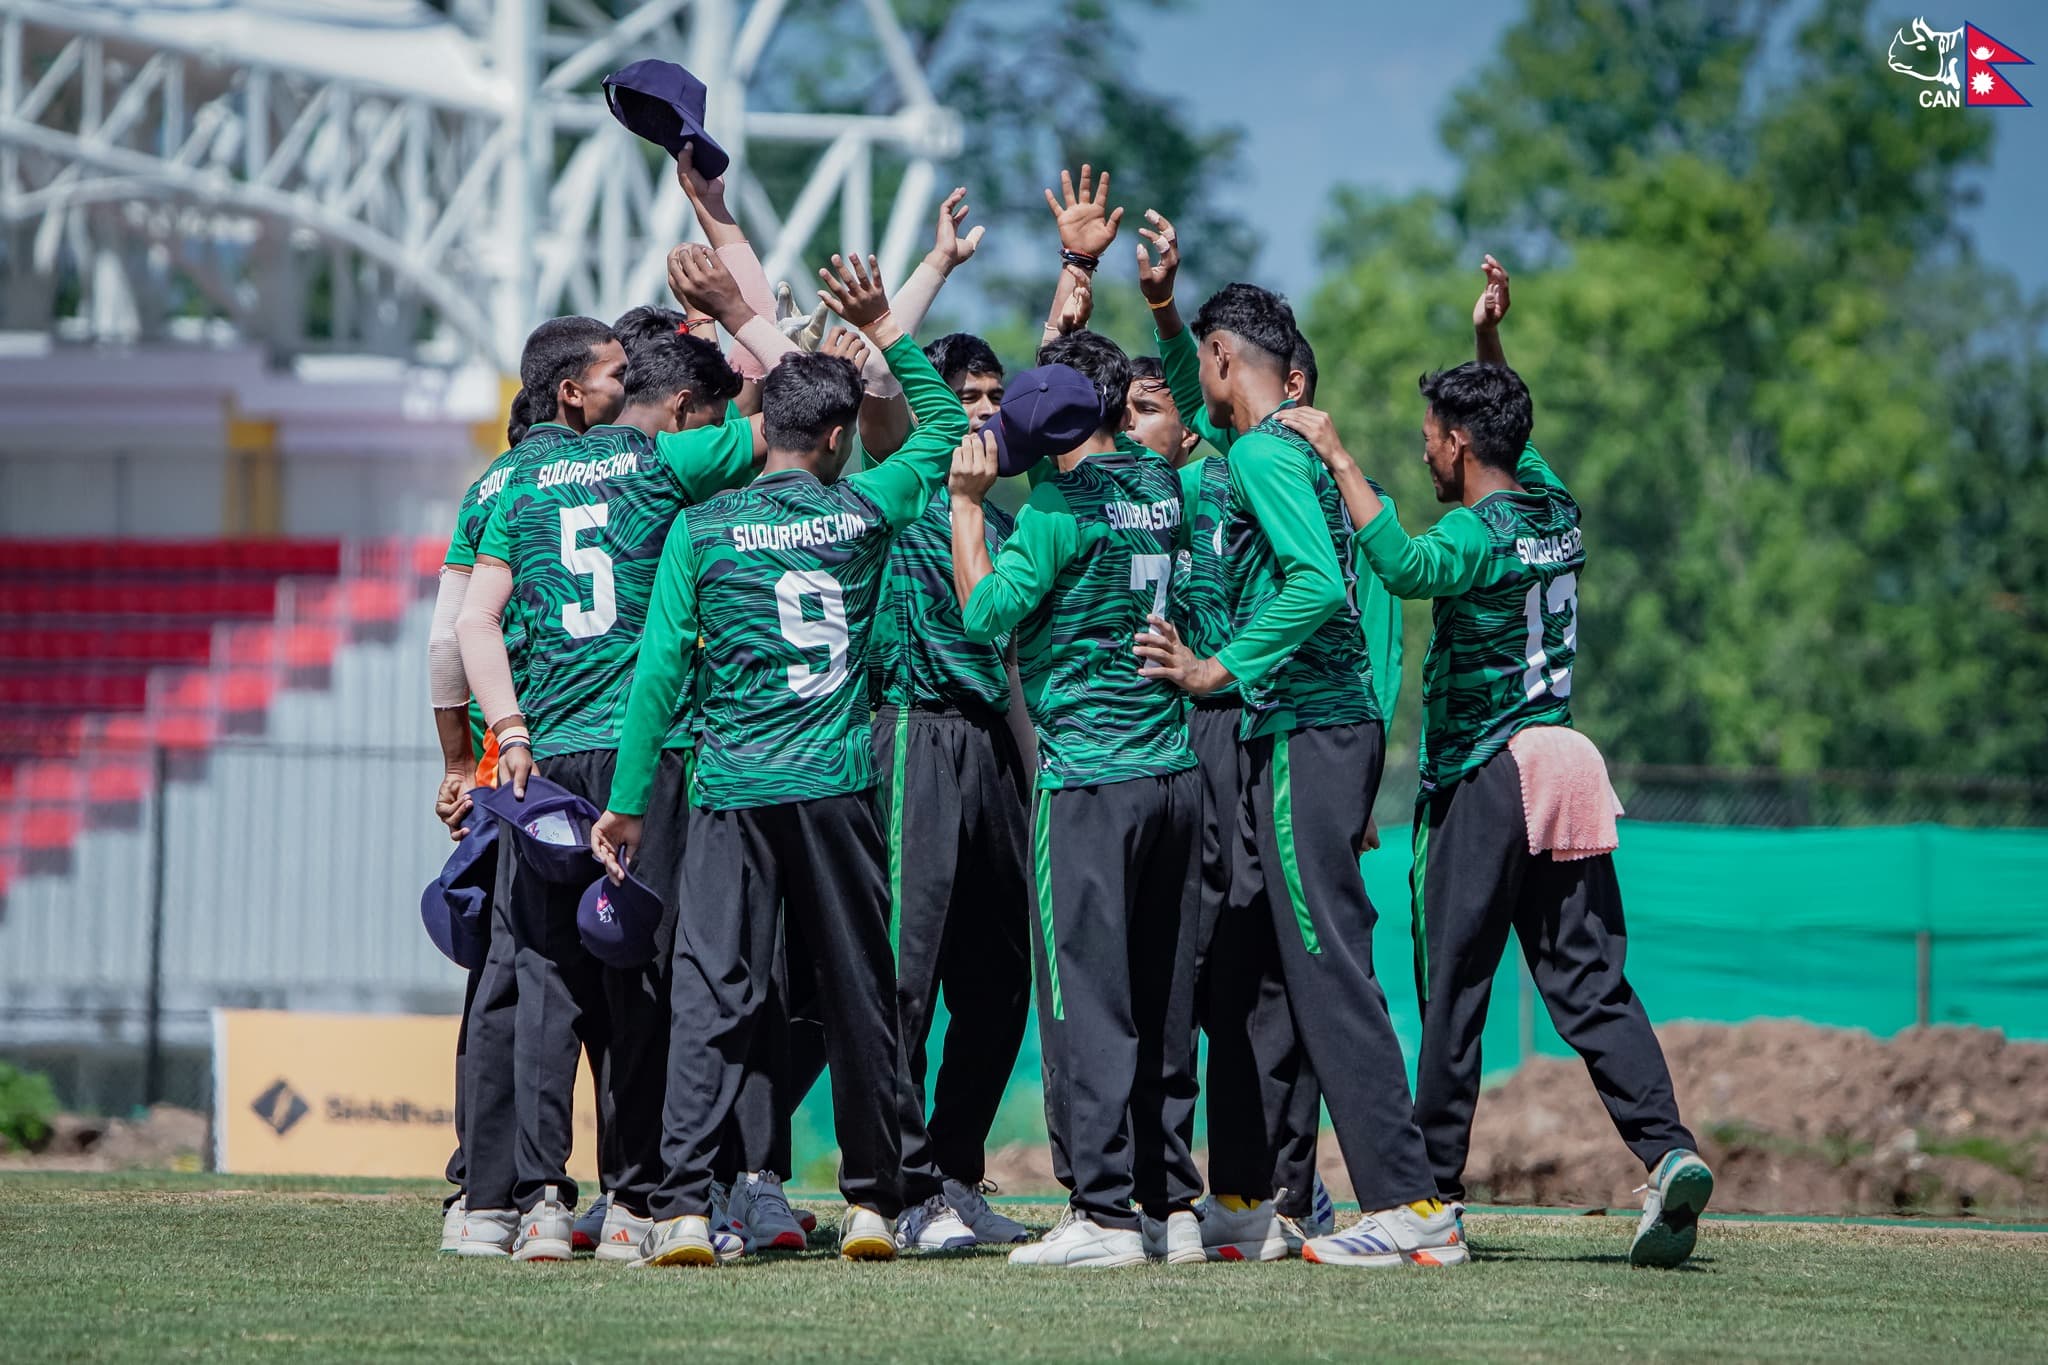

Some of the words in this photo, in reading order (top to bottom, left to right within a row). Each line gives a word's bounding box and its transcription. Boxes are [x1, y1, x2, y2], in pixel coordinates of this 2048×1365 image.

[559, 502, 617, 640] 5
[733, 512, 867, 553] SUDURPASCHIM
[774, 569, 850, 699] 9
[1129, 553, 1171, 672] 7
